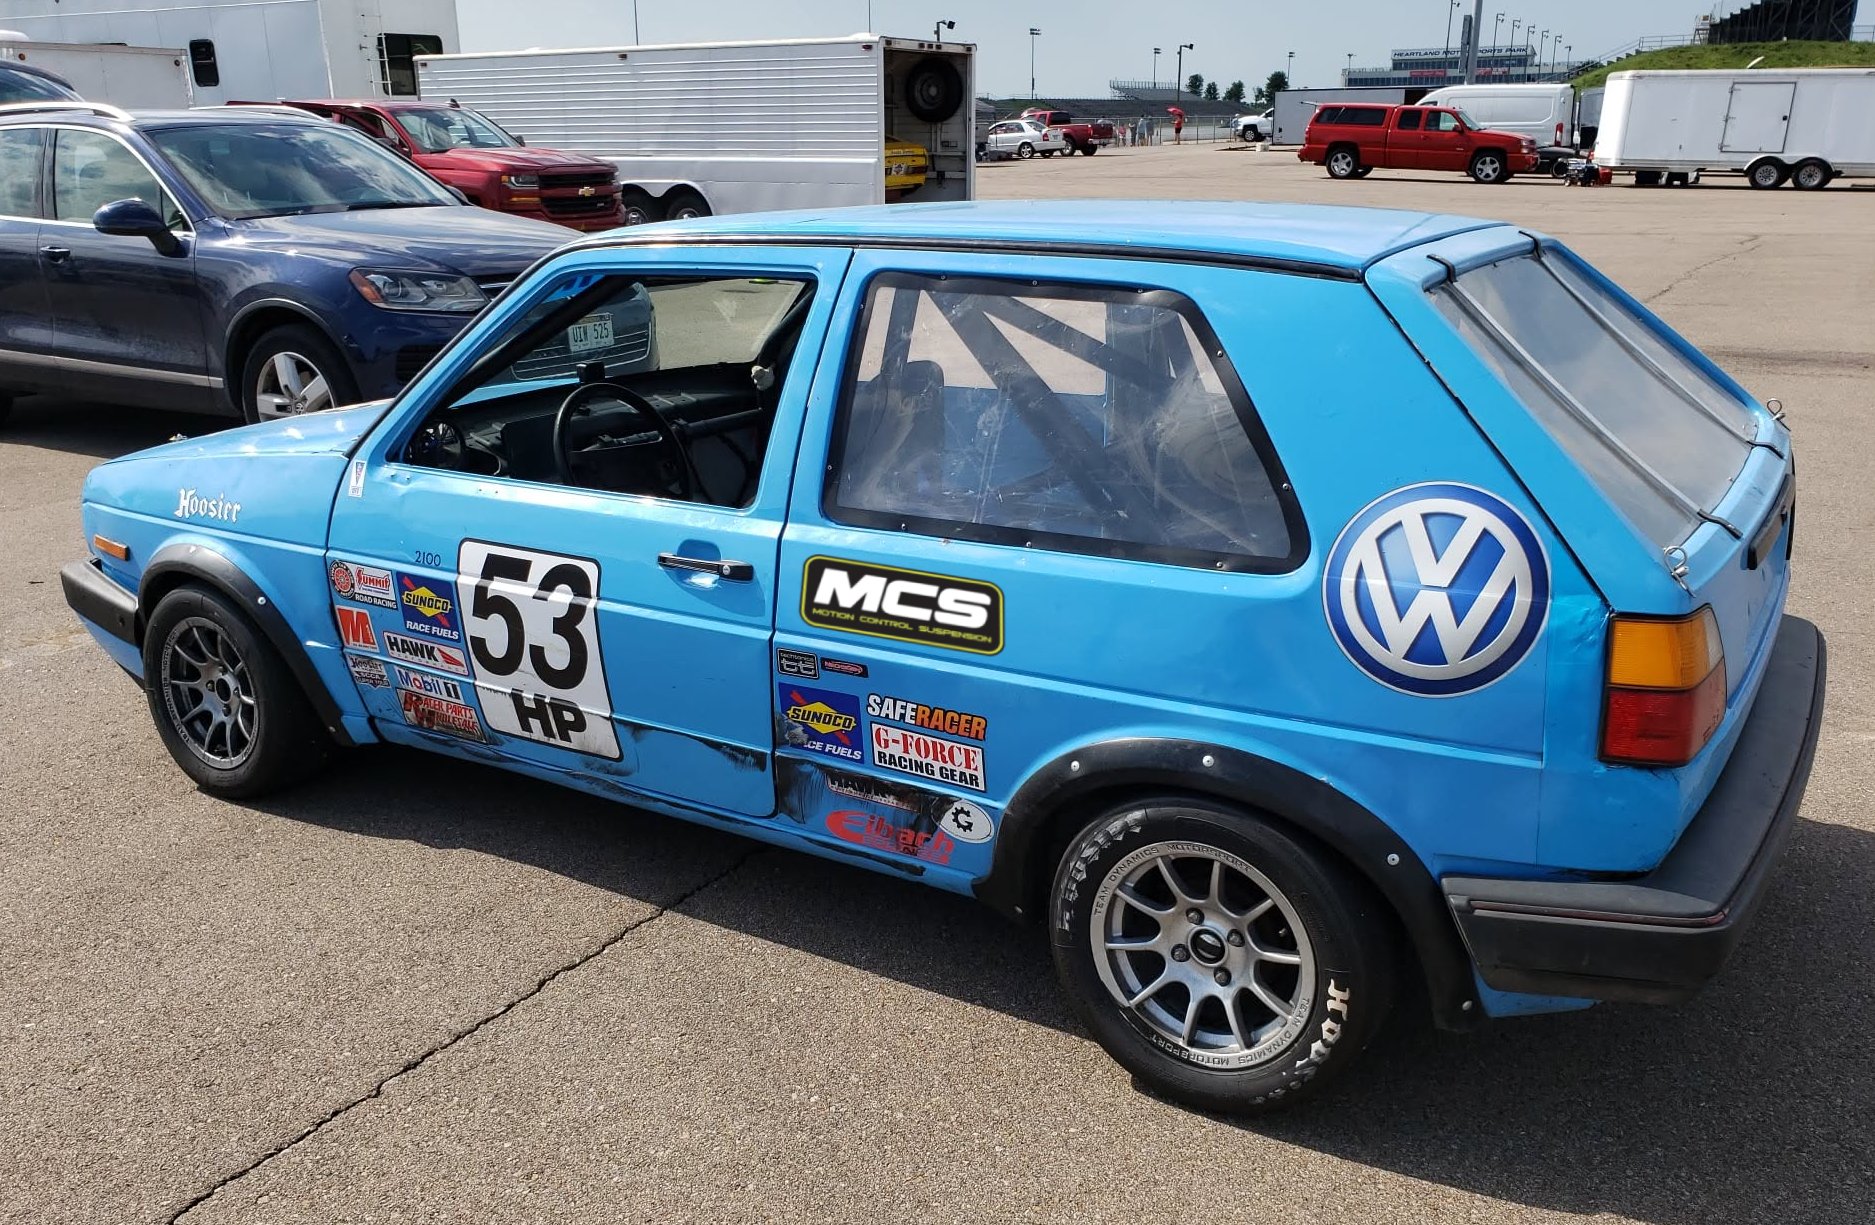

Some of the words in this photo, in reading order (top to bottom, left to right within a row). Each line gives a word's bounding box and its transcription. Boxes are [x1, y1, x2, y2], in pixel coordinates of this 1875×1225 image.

[593, 322, 609, 340] 525
[174, 487, 242, 523] Hoosier
[415, 550, 442, 567] 2100
[355, 593, 373, 604] ROAD
[373, 596, 397, 609] RACING
[405, 592, 450, 612] SUNOCO
[813, 567, 992, 629] MCS
[406, 620, 430, 633] RACE
[431, 626, 459, 639] FUELS
[470, 553, 591, 690] 53
[812, 608, 855, 621] MOTION
[859, 615, 913, 631] CONTROL
[918, 624, 993, 643] SUSPENSION
[387, 635, 439, 662] HAWK
[397, 668, 442, 696] Mobil
[444, 681, 461, 700] 1
[446, 701, 474, 719] PARTS
[511, 688, 587, 742] HP
[791, 707, 854, 729] SUNOCO
[867, 694, 986, 740] SAFERACER
[825, 744, 862, 760] FUELS
[874, 727, 979, 772] G-FORCE
[878, 751, 935, 776] RACING
[939, 766, 980, 788] GEAR
[1094, 886, 1112, 915] TEAM
[1108, 846, 1160, 882] DYNAMICS
[1292, 997, 1310, 1028] TEAM
[1237, 1030, 1293, 1064] DYNAMICS
